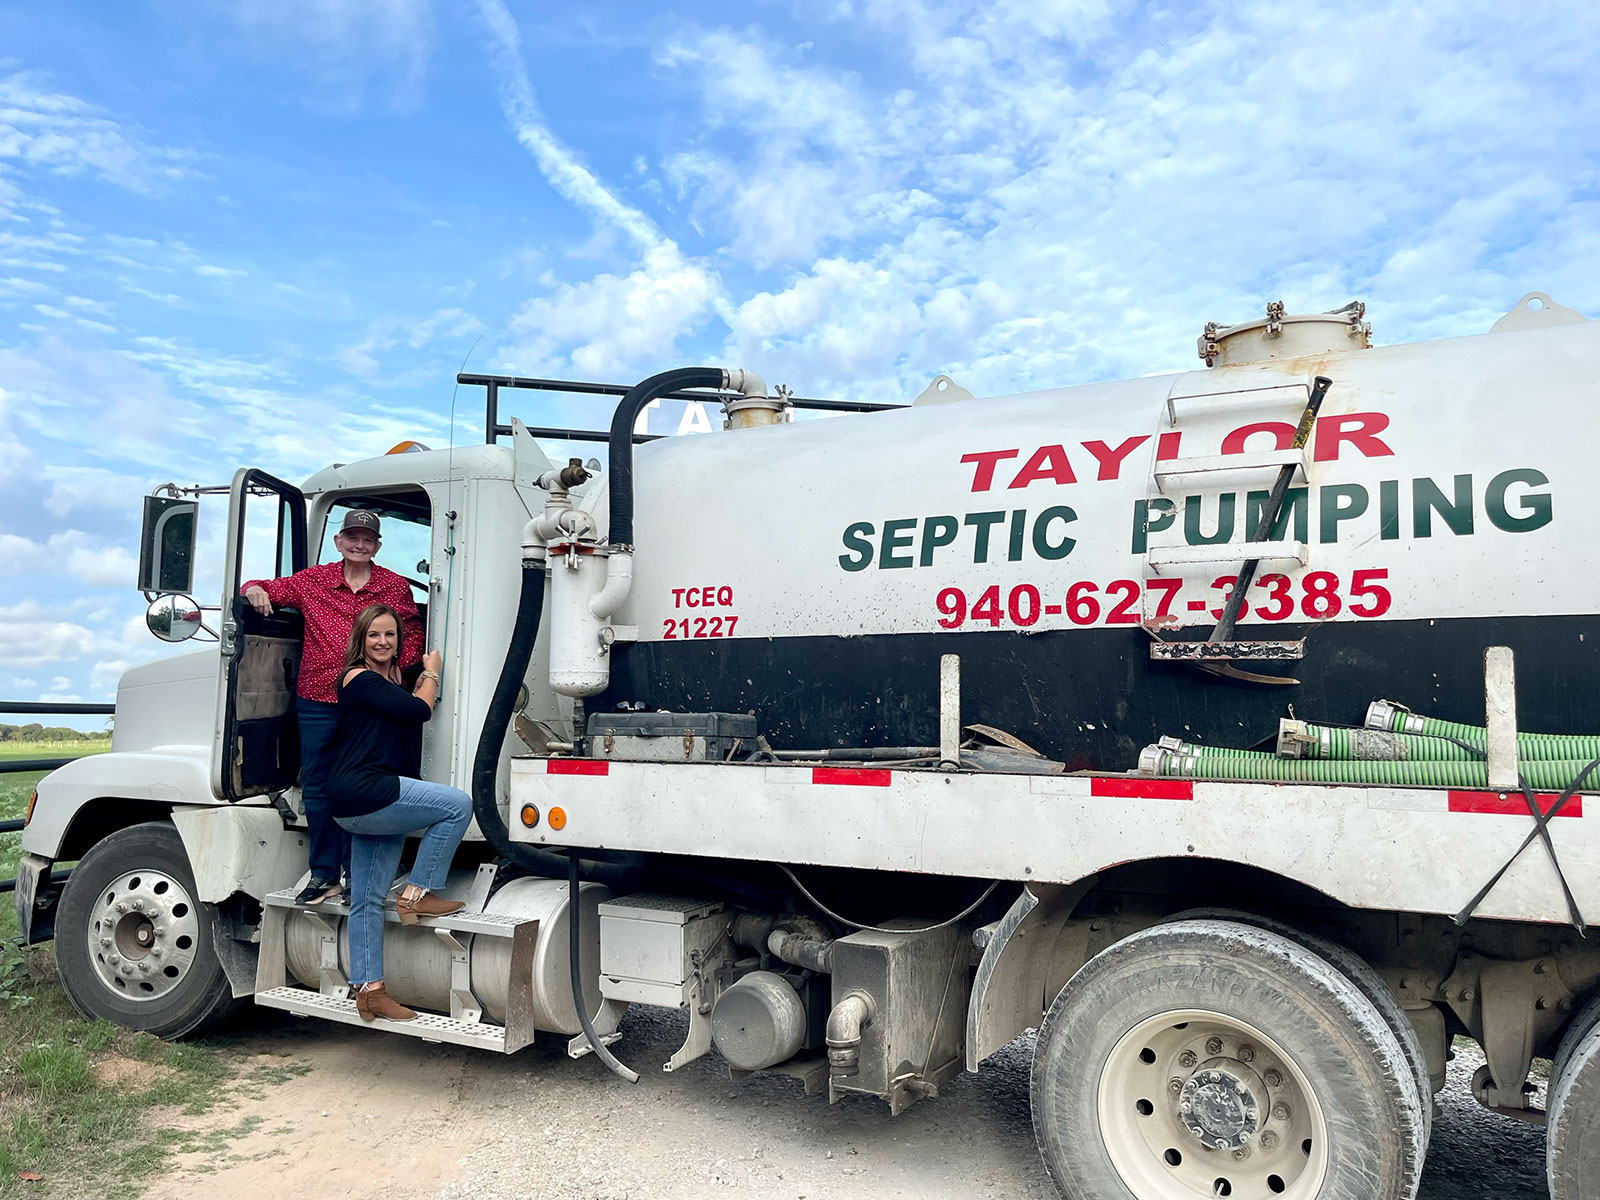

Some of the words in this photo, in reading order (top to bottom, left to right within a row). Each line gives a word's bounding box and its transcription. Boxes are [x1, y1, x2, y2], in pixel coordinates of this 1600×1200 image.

[960, 412, 1395, 492] TAYLOR
[838, 505, 1078, 572] SEPTIC
[1131, 467, 1554, 554] PUMPING
[663, 615, 739, 640] 21227
[671, 585, 734, 609] TCEQ
[935, 568, 1392, 629] 940-627-3385
